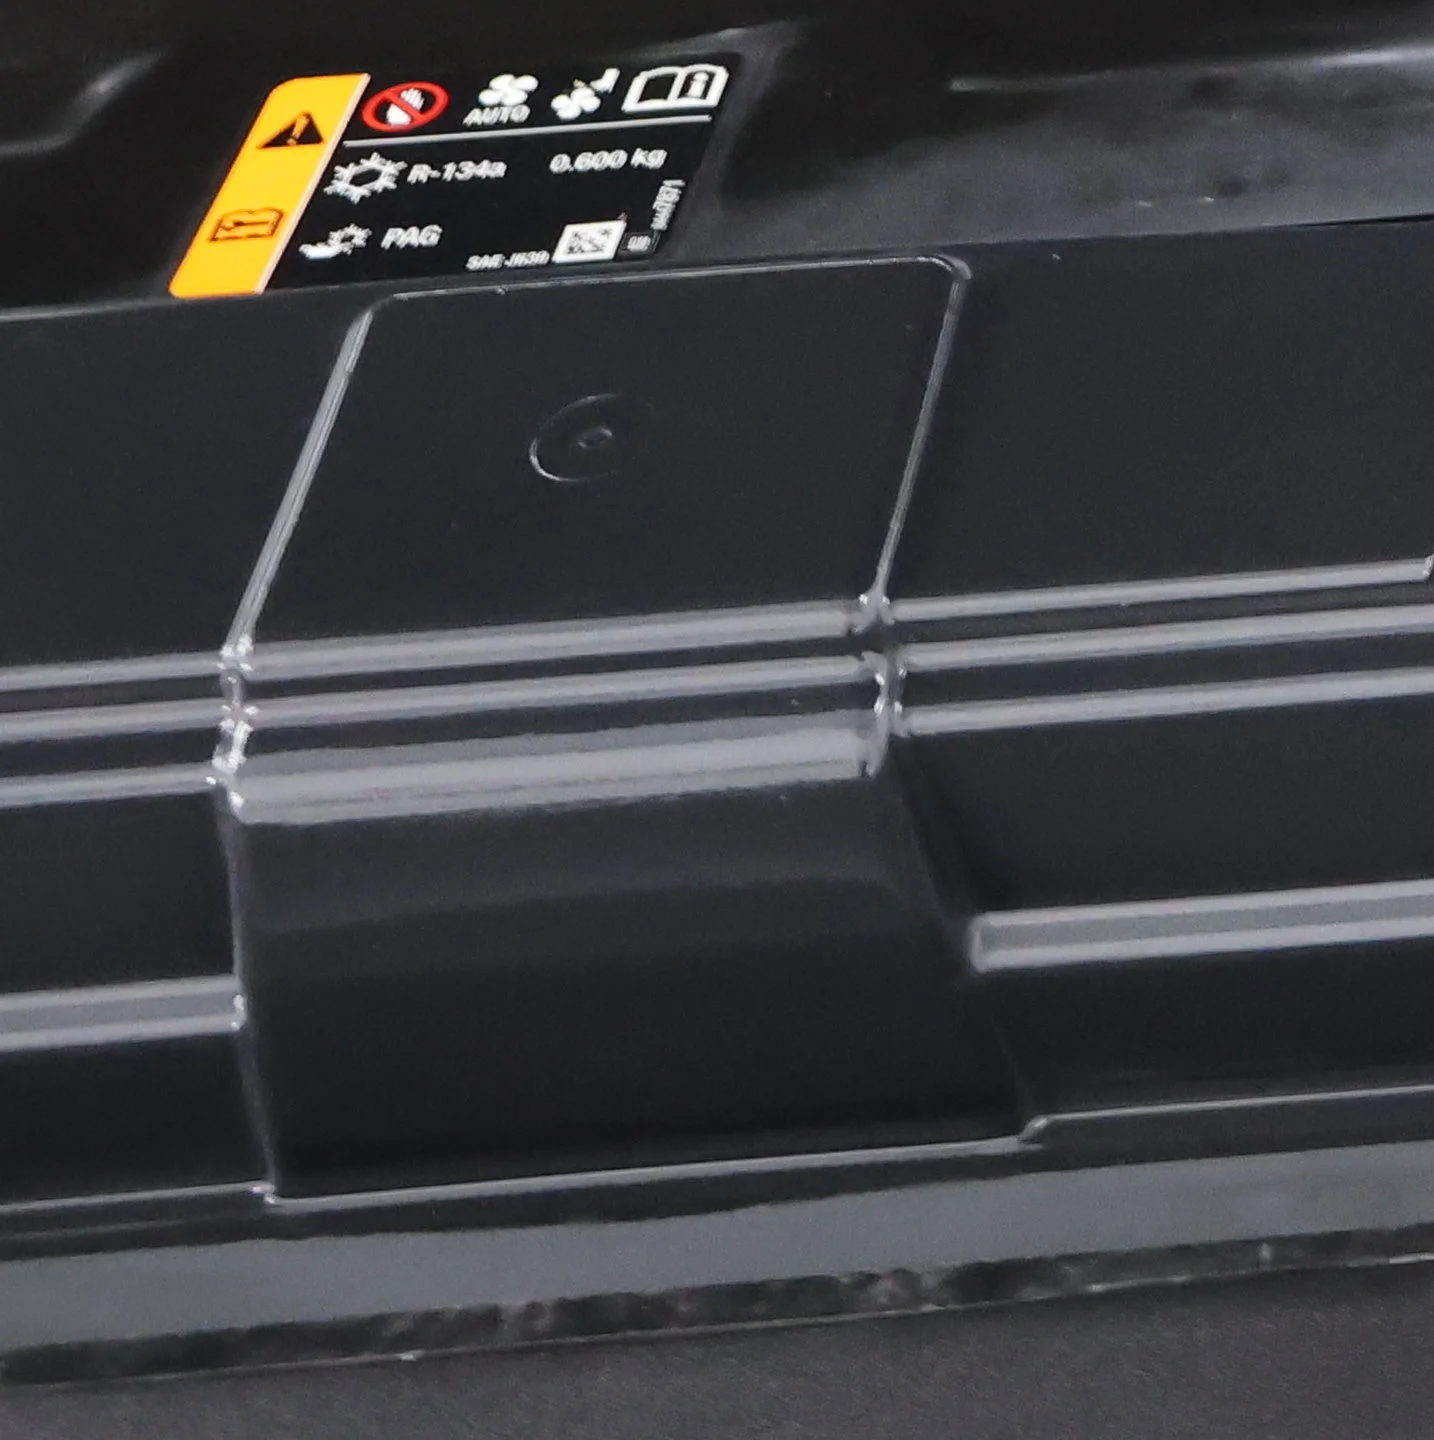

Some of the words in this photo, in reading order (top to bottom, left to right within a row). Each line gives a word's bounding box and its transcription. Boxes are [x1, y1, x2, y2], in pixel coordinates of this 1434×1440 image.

[463, 105, 530, 127] AUTO
[406, 160, 507, 184] R-134a
[550, 150, 628, 174] 0.600
[630, 148, 667, 170] kg
[380, 225, 443, 249] PAG
[465, 255, 505, 270] SAE
